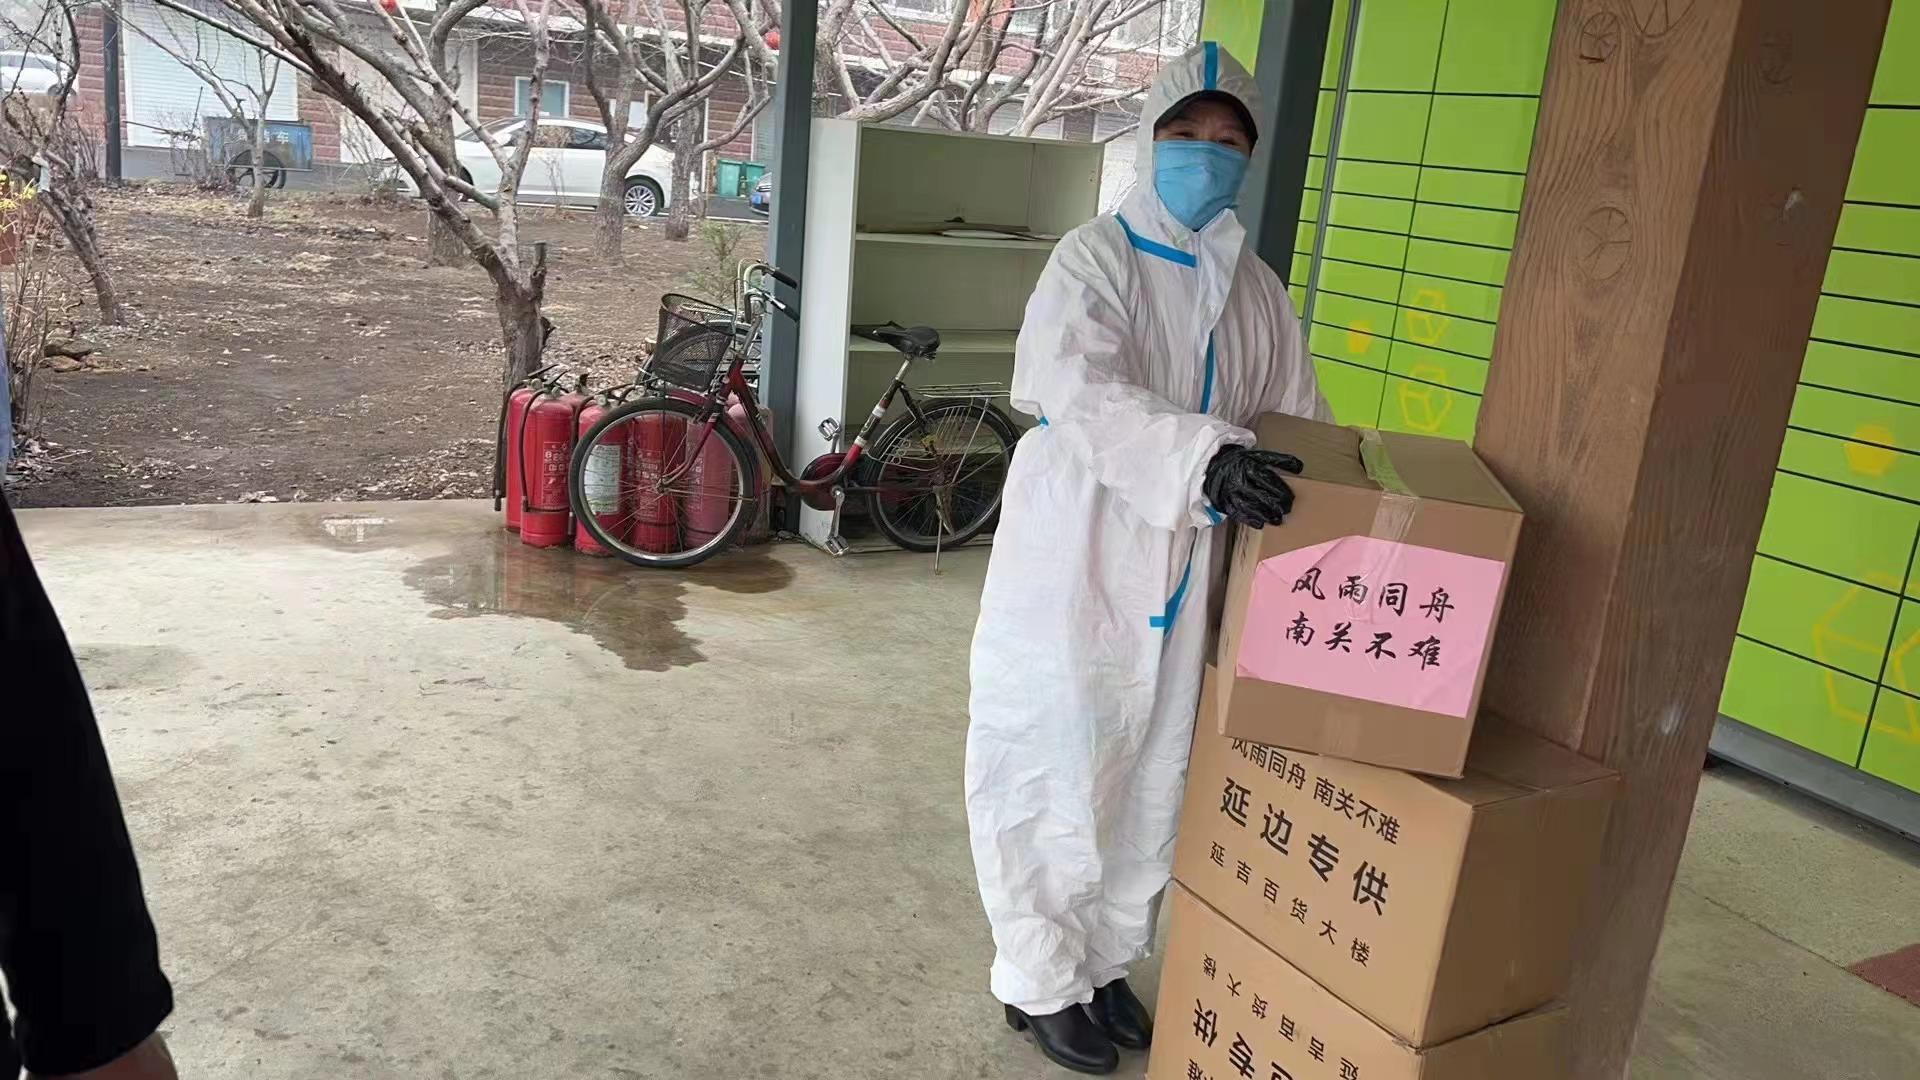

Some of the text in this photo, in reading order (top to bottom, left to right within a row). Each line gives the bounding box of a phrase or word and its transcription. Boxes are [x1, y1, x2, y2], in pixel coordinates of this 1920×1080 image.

[1291, 567, 1455, 623] 风雨同舟
[1285, 611, 1441, 671] 南关不难
[1313, 776, 1401, 845] 南关不难
[1219, 777, 1390, 916] 延边专供
[1208, 840, 1371, 967] 延吉百货大楼
